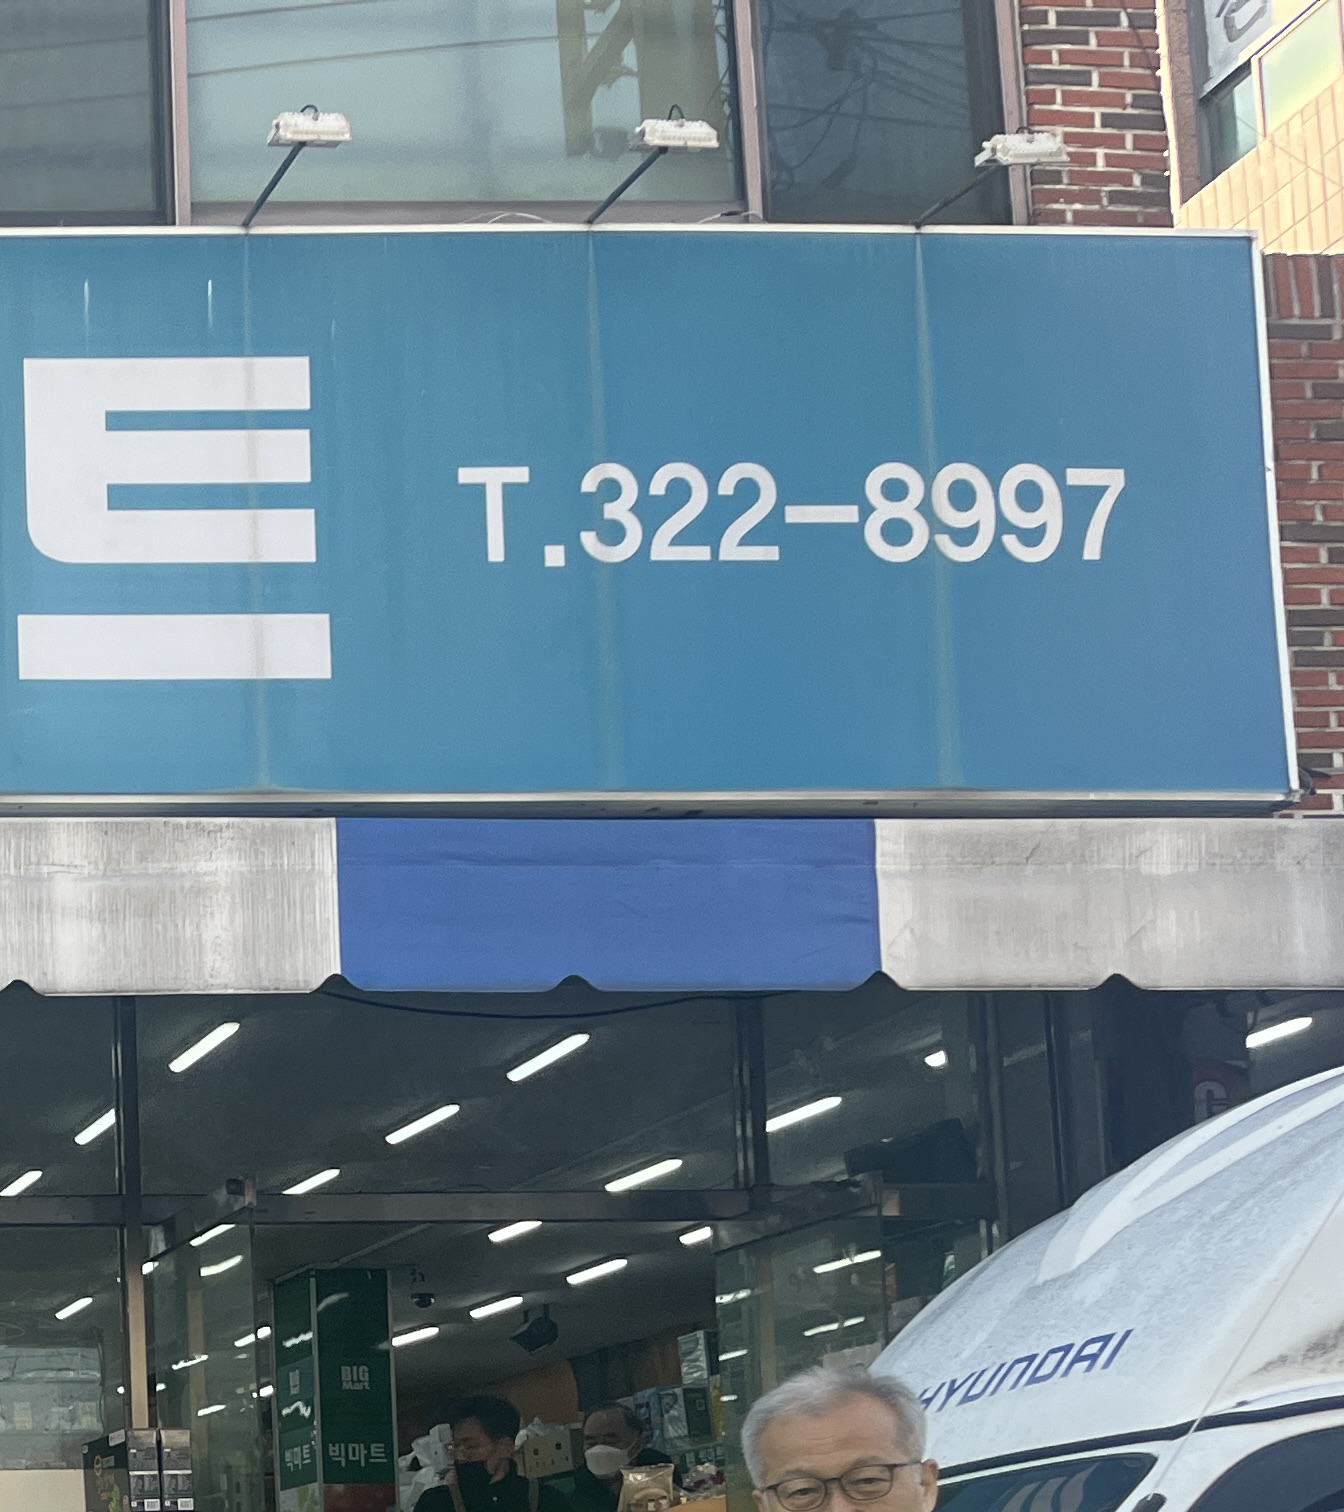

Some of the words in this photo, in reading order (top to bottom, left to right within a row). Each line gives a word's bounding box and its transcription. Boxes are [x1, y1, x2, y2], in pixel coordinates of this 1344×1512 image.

[459, 463, 1124, 567] T.322-8997
[341, 1365, 370, 1381] BIG
[918, 1328, 1134, 1413] HYUNDAI
[341, 1381, 371, 1390] Mart
[328, 1443, 388, 1468] 빅마트
